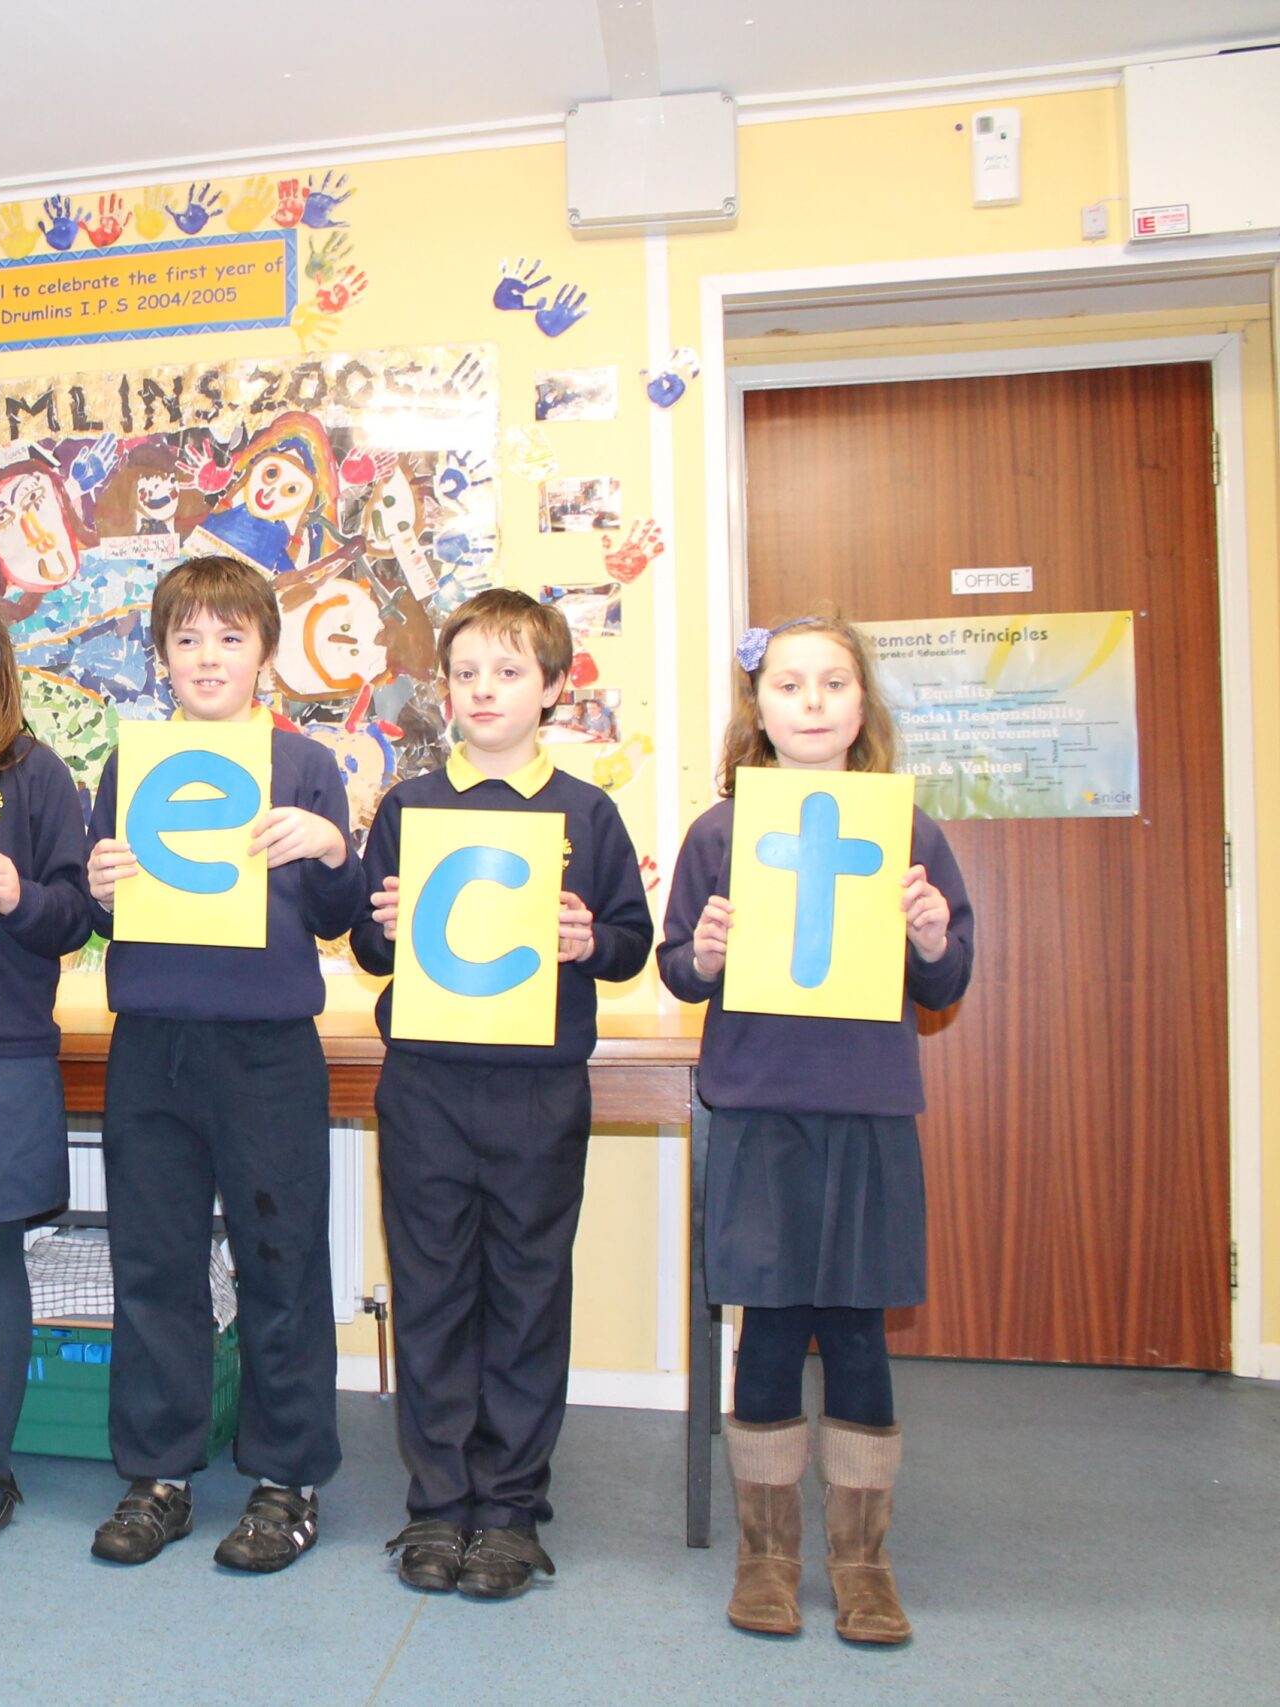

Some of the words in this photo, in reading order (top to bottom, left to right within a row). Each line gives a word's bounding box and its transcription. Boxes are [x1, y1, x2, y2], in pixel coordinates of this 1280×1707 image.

[13, 282, 30, 298] to
[37, 273, 120, 296] celebrate
[128, 269, 158, 286] the
[166, 263, 207, 284] first
[215, 262, 256, 282] year
[264, 256, 285, 274] of
[1, 303, 73, 325] Drumlins
[80, 298, 129, 316] I.P.S
[137, 287, 238, 311] 2004/2005
[964, 572, 1021, 589] OFFICE
[938, 630, 957, 645] of
[962, 626, 1049, 646] Principles
[879, 649, 914, 661] grated
[917, 646, 967, 658] Education
[920, 686, 995, 703] Equality
[900, 709, 952, 724] Social
[958, 706, 1087, 724] Responsibility
[899, 728, 948, 743] ental
[953, 726, 1061, 742] Involvement
[937, 762, 954, 775] &
[959, 760, 1023, 775] Values
[125, 749, 261, 894] e
[755, 791, 885, 989] t
